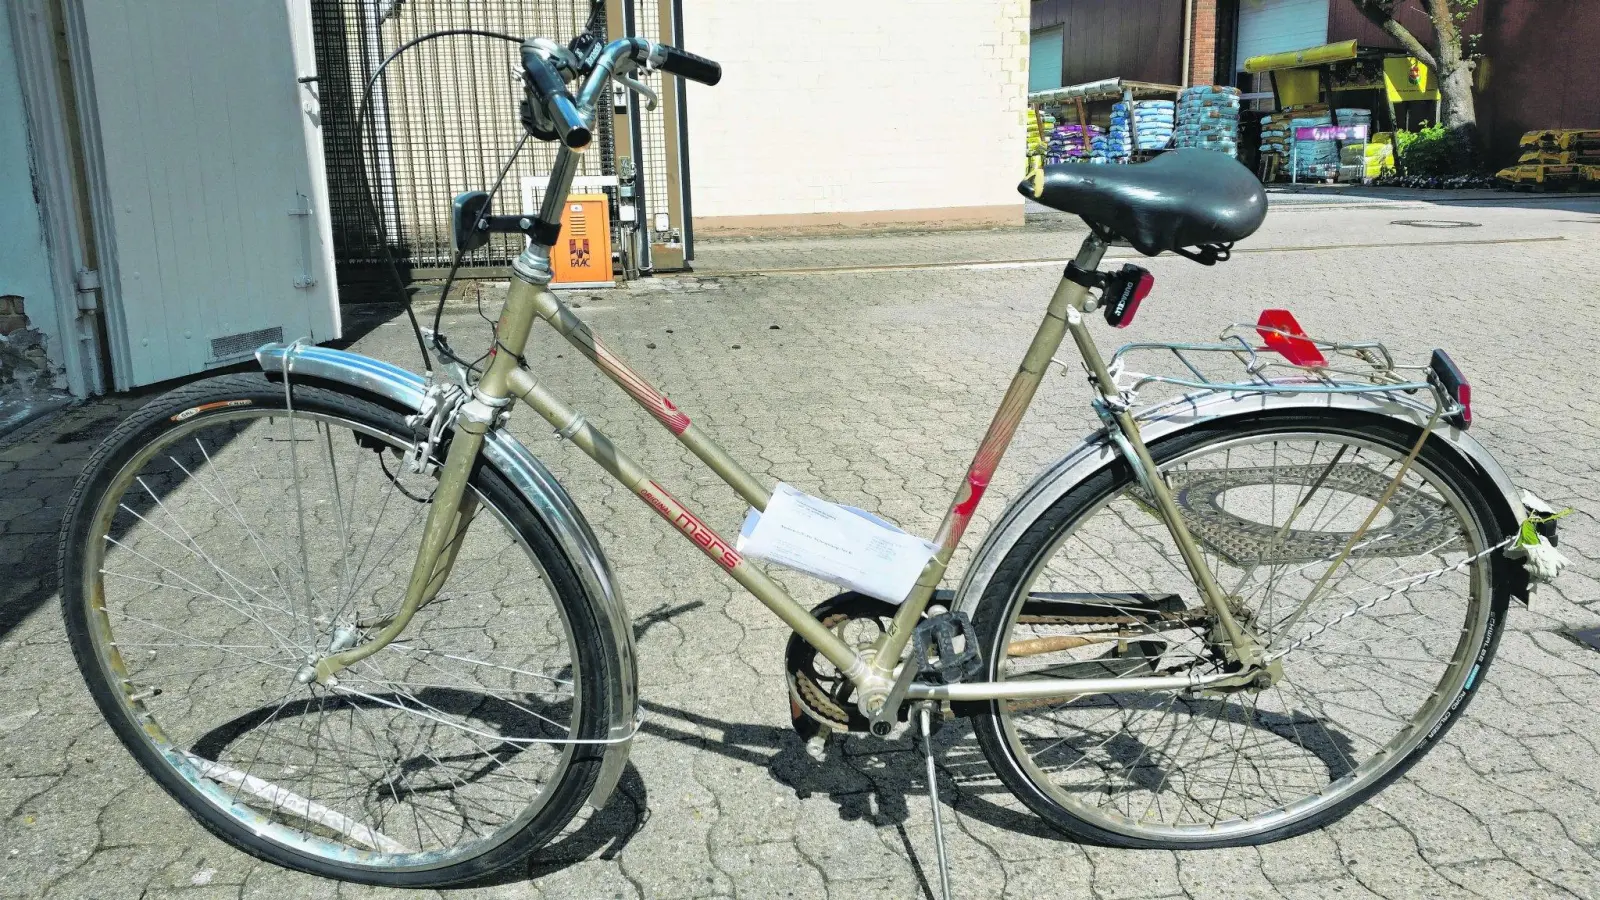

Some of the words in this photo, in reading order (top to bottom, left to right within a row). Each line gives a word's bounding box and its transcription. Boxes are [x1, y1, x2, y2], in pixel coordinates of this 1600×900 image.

[570, 258, 590, 267] FAAC
[640, 488, 672, 516] ORIGINAL
[675, 513, 738, 568] mars
